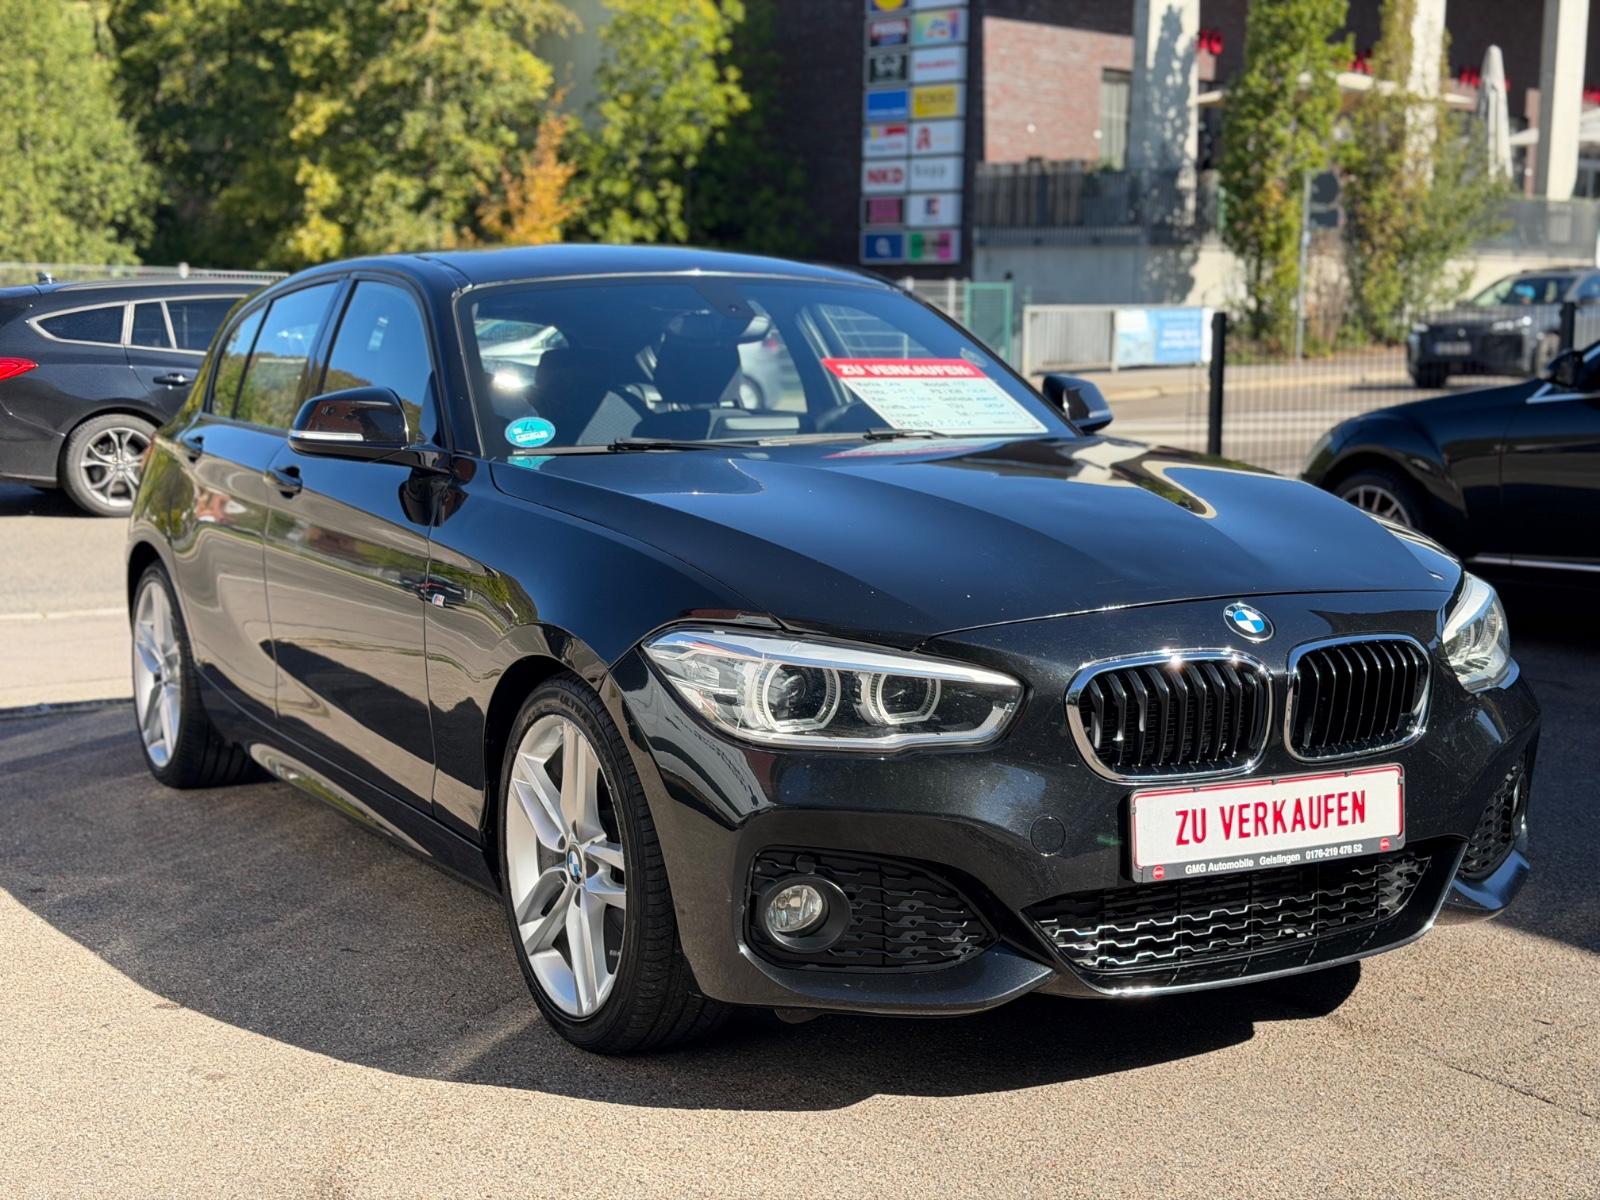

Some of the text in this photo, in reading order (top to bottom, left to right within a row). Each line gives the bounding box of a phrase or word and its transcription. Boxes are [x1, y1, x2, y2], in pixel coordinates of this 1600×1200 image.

[837, 364, 865, 375] ZU
[1175, 790, 1365, 846] ZU VERKAUFEN
[1185, 862, 1206, 875] GMG
[1207, 858, 1254, 872] Automobile
[1259, 852, 1301, 866] Geislingen
[1353, 843, 1363, 853] 52
